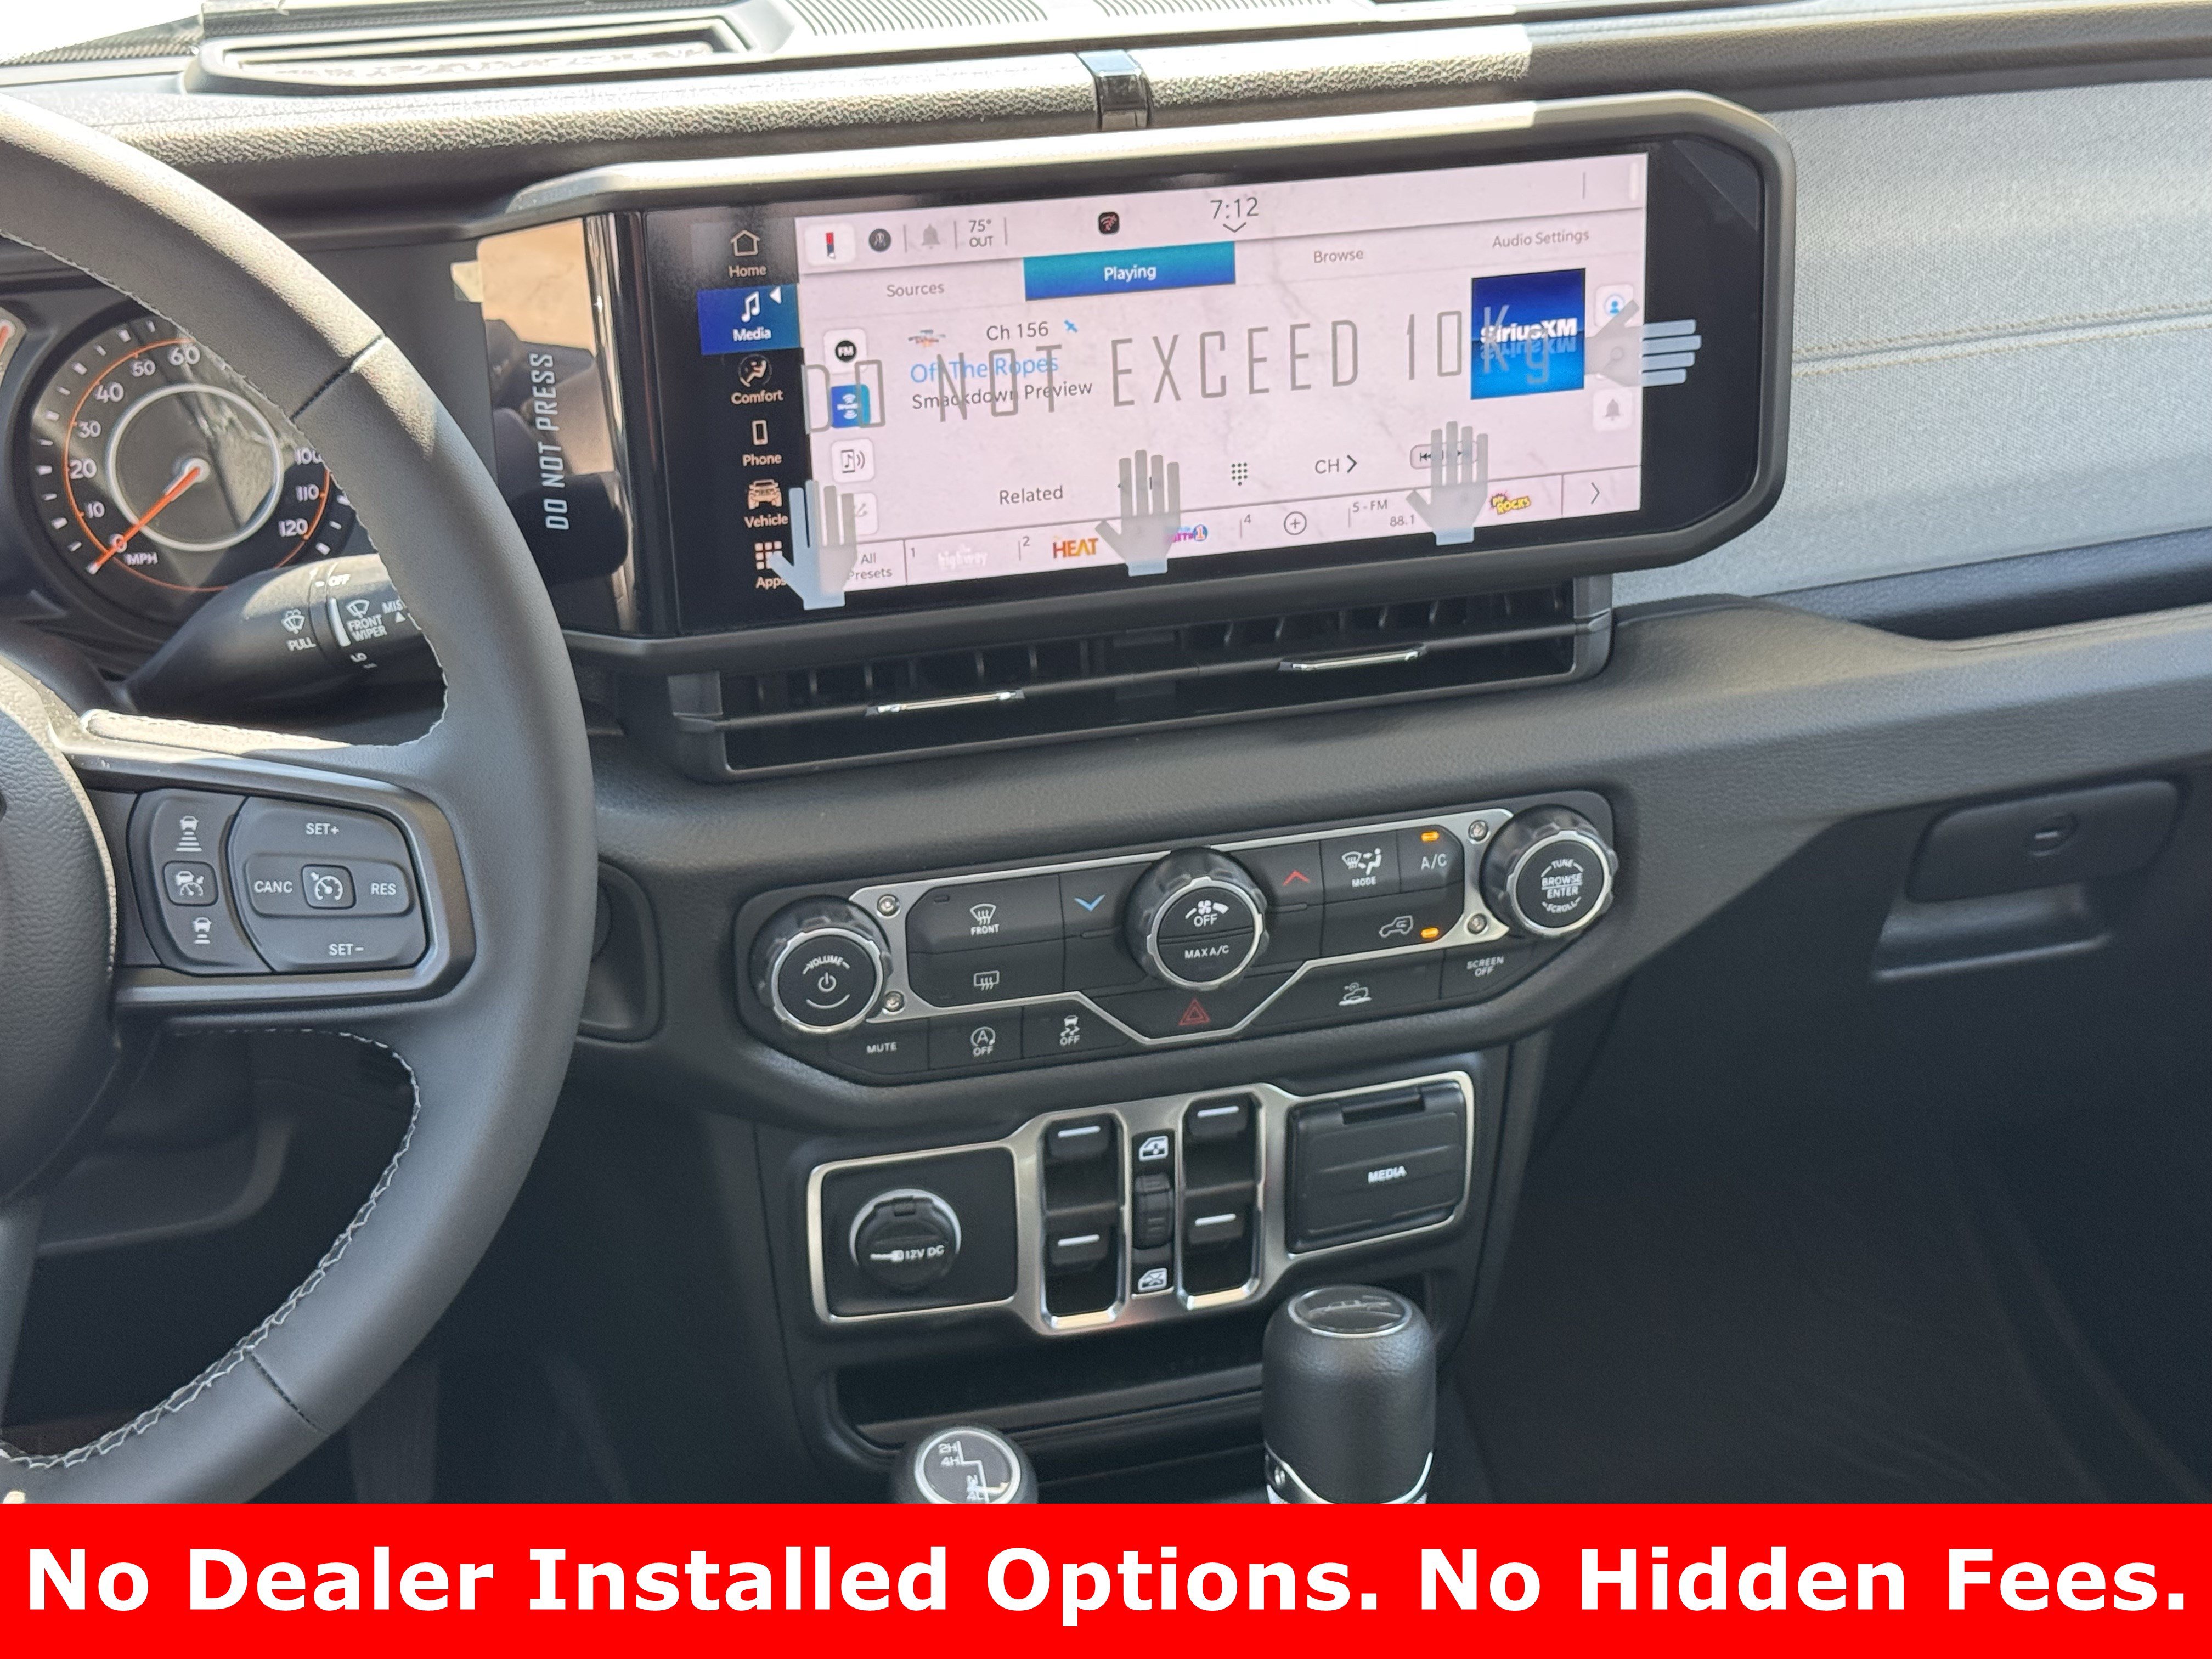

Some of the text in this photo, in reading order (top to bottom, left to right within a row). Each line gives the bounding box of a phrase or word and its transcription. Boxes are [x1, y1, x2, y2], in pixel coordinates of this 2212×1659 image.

[1210, 196, 1259, 220] 7:12
[969, 236, 994, 248] OUT
[1492, 228, 1589, 250] Audio Settings
[1313, 248, 1364, 264] Browse
[728, 265, 767, 278] Home
[1104, 264, 1157, 284] Playing
[886, 281, 945, 298] Sources
[732, 328, 771, 342] Media
[986, 323, 1049, 341] Ch 156
[168, 347, 200, 365] 60
[837, 346, 854, 357] FM
[132, 360, 156, 376] 50
[937, 343, 1063, 422] NOT
[1111, 319, 1359, 410] EXCEED
[1406, 310, 1463, 381] 10
[949, 360, 988, 379] The
[995, 357, 1059, 377] Ropes
[94, 382, 124, 402] 40
[731, 388, 785, 404] Comfort
[1024, 381, 1093, 400] Preview
[77, 420, 101, 438] 30
[529, 353, 569, 530] DO NOT PRESS
[742, 453, 782, 467] Phone
[1314, 458, 1340, 474] CH
[69, 459, 97, 479] 20
[295, 484, 319, 501] 110
[999, 486, 1064, 505] Related
[84, 500, 105, 518] 10
[1352, 501, 1360, 513] 5
[1370, 499, 1388, 511] FM
[278, 518, 308, 537] 120
[744, 514, 788, 529] Vehicle
[1389, 514, 1415, 527] 88.1
[1023, 535, 1031, 547] 2
[1052, 537, 1098, 559] HEAT
[126, 552, 158, 565] MPH
[861, 552, 877, 564] All
[911, 547, 916, 557] 1
[347, 614, 382, 631] FRONT
[351, 625, 387, 642] WIPER
[286, 637, 317, 652] PULL
[1421, 854, 1447, 870] A/C
[1551, 859, 1573, 869] TUNE
[254, 881, 293, 894] CANC
[1352, 877, 1376, 887] MODE
[1542, 873, 1582, 887] BROWSE
[371, 883, 396, 896] RES
[1547, 886, 1578, 899] ENTER
[1546, 901, 1578, 913] SCROLL
[1194, 913, 1218, 927] OFF
[971, 924, 999, 935] FRONT
[1185, 945, 1230, 959] MAX A/C
[809, 955, 843, 969] VOLUME
[1467, 956, 1504, 970] SCREEN
[1475, 966, 1494, 977] OFF
[1060, 1034, 1079, 1045] OFF
[867, 1042, 897, 1053] MUTE
[973, 1045, 994, 1056] OFF
[1368, 1166, 1406, 1183] MEDIA
[905, 1244, 945, 1260] 12V DC
